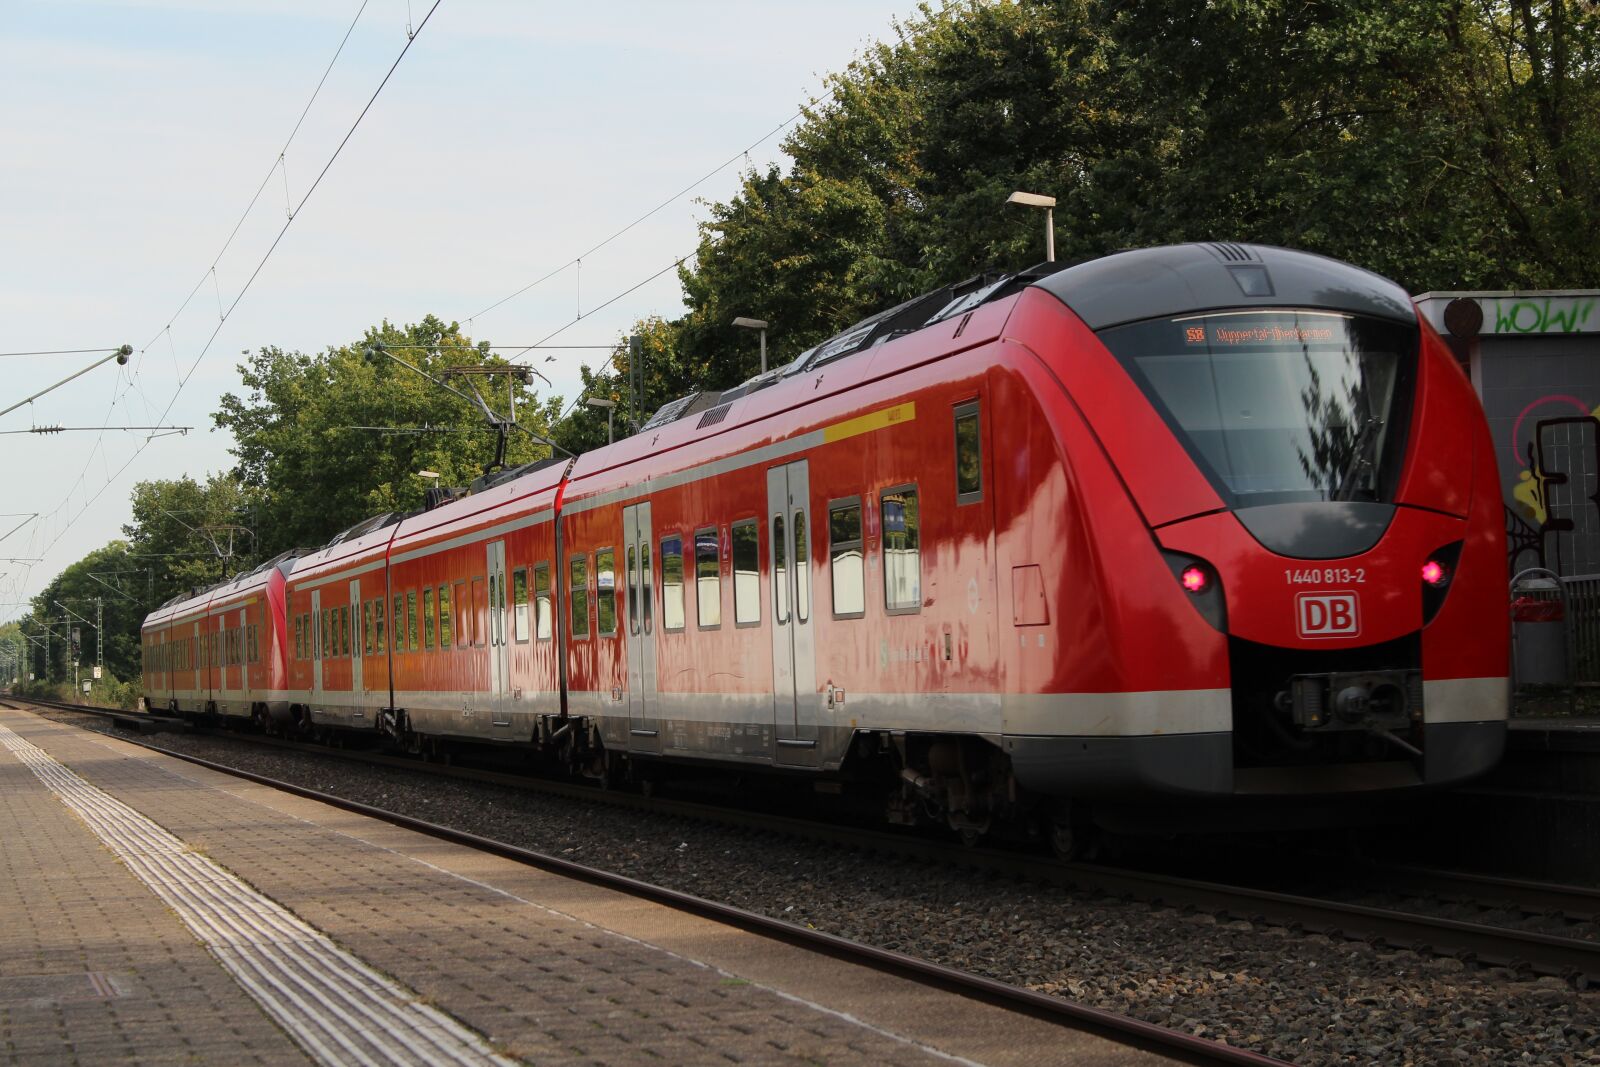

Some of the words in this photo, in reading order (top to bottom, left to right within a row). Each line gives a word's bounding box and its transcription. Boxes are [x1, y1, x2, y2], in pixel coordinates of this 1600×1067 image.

[1284, 569, 1321, 585] 1440
[1324, 568, 1366, 584] 813-2
[1303, 598, 1354, 632] DB
